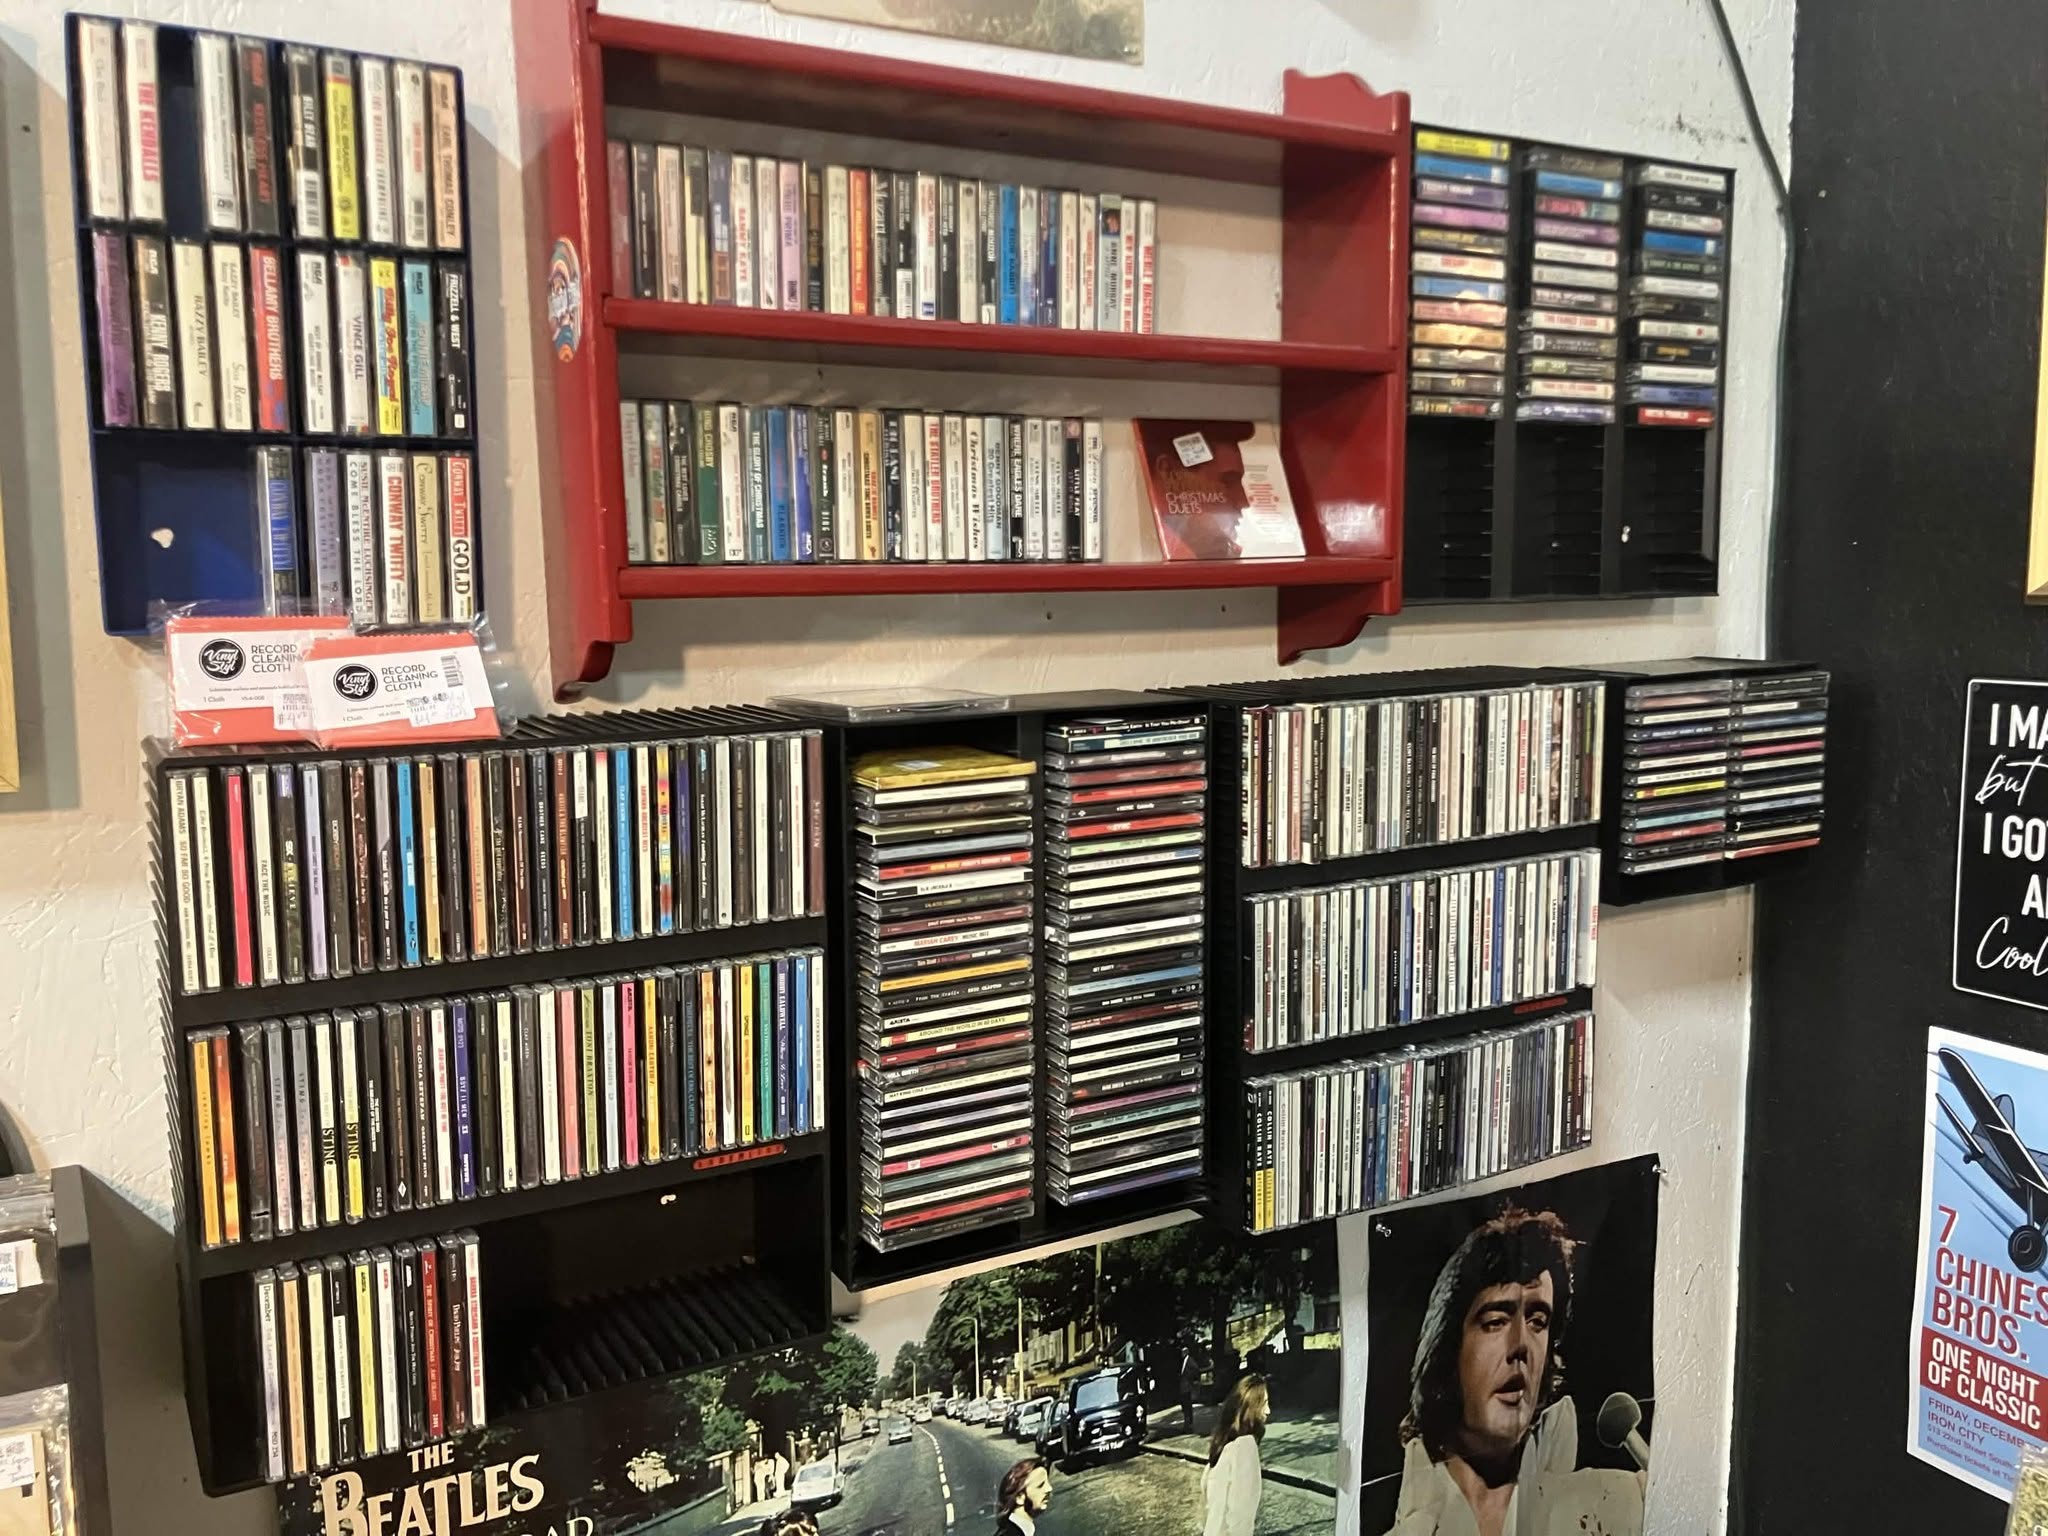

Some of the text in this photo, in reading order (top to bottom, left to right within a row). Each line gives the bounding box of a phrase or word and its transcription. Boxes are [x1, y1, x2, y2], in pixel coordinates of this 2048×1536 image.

[138, 82, 159, 105] THE
[1110, 272, 1119, 310] MURRAY
[262, 256, 283, 381] BELLAMY BROTHERS
[448, 274, 461, 349] FRIZZELL & WEST
[150, 313, 172, 392] KENNY ROGERS
[352, 315, 364, 380] VINCE GILL
[704, 433, 715, 468] CROSBY
[349, 461, 359, 497] COME
[360, 462, 369, 491] SUSIE
[752, 431, 764, 529] THE GLORY OF CHRISTMAS
[929, 423, 942, 524] THE STATLER BROTHERS
[969, 431, 981, 550] Christmas Wishes
[1014, 458, 1024, 519] EAGLES DARE
[452, 461, 468, 536] CONWAY TWITTY
[988, 505, 996, 524] Hits
[995, 478, 1003, 529] GOODMAN
[1165, 492, 1225, 504] CHRISTMAS
[1168, 502, 1202, 515] DUETS
[351, 504, 360, 542] BLESS
[387, 476, 405, 582] CONWAY TWITTY
[353, 549, 362, 572] THE
[452, 539, 471, 596] GOLD
[204, 648, 239, 663] Vinyl
[205, 660, 236, 675] Styl
[250, 644, 298, 655] RECORD
[251, 652, 305, 664] CLEANIN
[251, 662, 292, 674] CLOTH
[337, 671, 371, 686] Vinyl
[381, 664, 427, 677] RECORD
[382, 670, 439, 685] CLEANING
[341, 682, 369, 697] Styl
[384, 680, 423, 694] CLOTH
[1989, 702, 2001, 746] I
[1974, 753, 2048, 807] but
[175, 780, 191, 904] BRYAN ADAMS SO FAR SO GOOD
[538, 801, 548, 870] BROTHER CANE SEEDS
[1982, 811, 2048, 863] I GO
[260, 860, 271, 917] FACE THE MUSIC
[1975, 915, 2048, 977] Cool
[779, 995, 787, 1031] CALDWELL
[919, 1028, 941, 1038] AROUND
[941, 1026, 956, 1035] THE
[956, 1023, 977, 1032] WORLD
[991, 1017, 1007, 1026] DAYS
[585, 1030, 595, 1097] TONI BRAXTON
[416, 1044, 426, 1121] GLORIA ESTEFAN
[459, 1075, 468, 1093] BOYZ
[460, 1103, 469, 1119] MEN
[420, 1125, 428, 1161] GREATEST
[1937, 1203, 1958, 1245] 7
[263, 1285, 273, 1323] December
[425, 1284, 434, 1297] THE
[1931, 1285, 2031, 1364] BROS.
[427, 1329, 437, 1363] CHRISTMAS
[1931, 1336, 2041, 1403] ONE NIGHT
[1927, 1359, 2042, 1431] OF CLASSIC
[1927, 1396, 1971, 1427] FRIDAY,
[271, 1431, 279, 1446] MSD
[1927, 1410, 1986, 1446] IRON CITY
[406, 1440, 456, 1475] THE
[1963, 1439, 1988, 1457] Street
